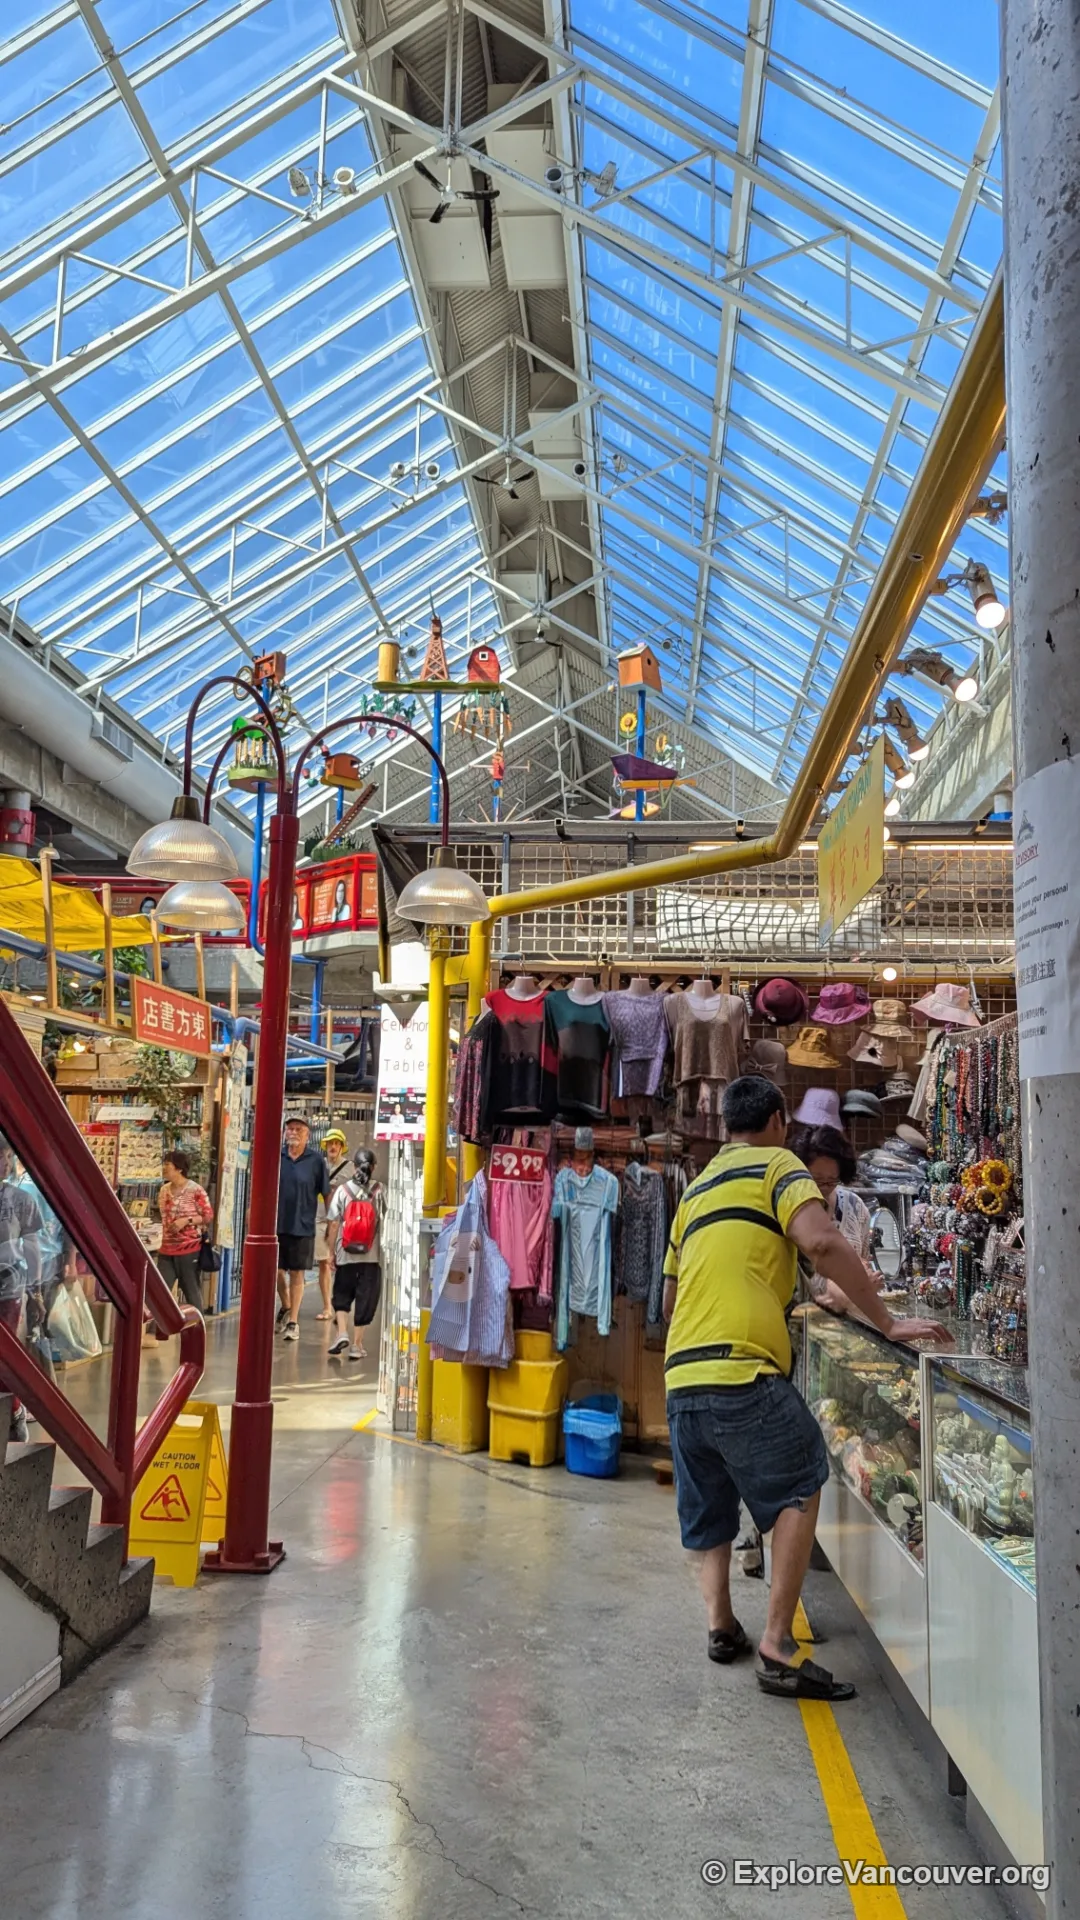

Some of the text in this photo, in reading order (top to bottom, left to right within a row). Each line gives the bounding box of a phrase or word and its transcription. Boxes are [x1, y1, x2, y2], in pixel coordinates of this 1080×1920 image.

[1043, 882, 1068, 901] personal
[1041, 919, 1063, 935] patronage
[1064, 917, 1070, 926] in
[404, 1037, 413, 1051] &
[384, 1058, 428, 1073] Table
[493, 1151, 543, 1176] $9.99
[162, 1452, 196, 1461] CAUTION
[153, 1461, 201, 1470] WET FLOOR
